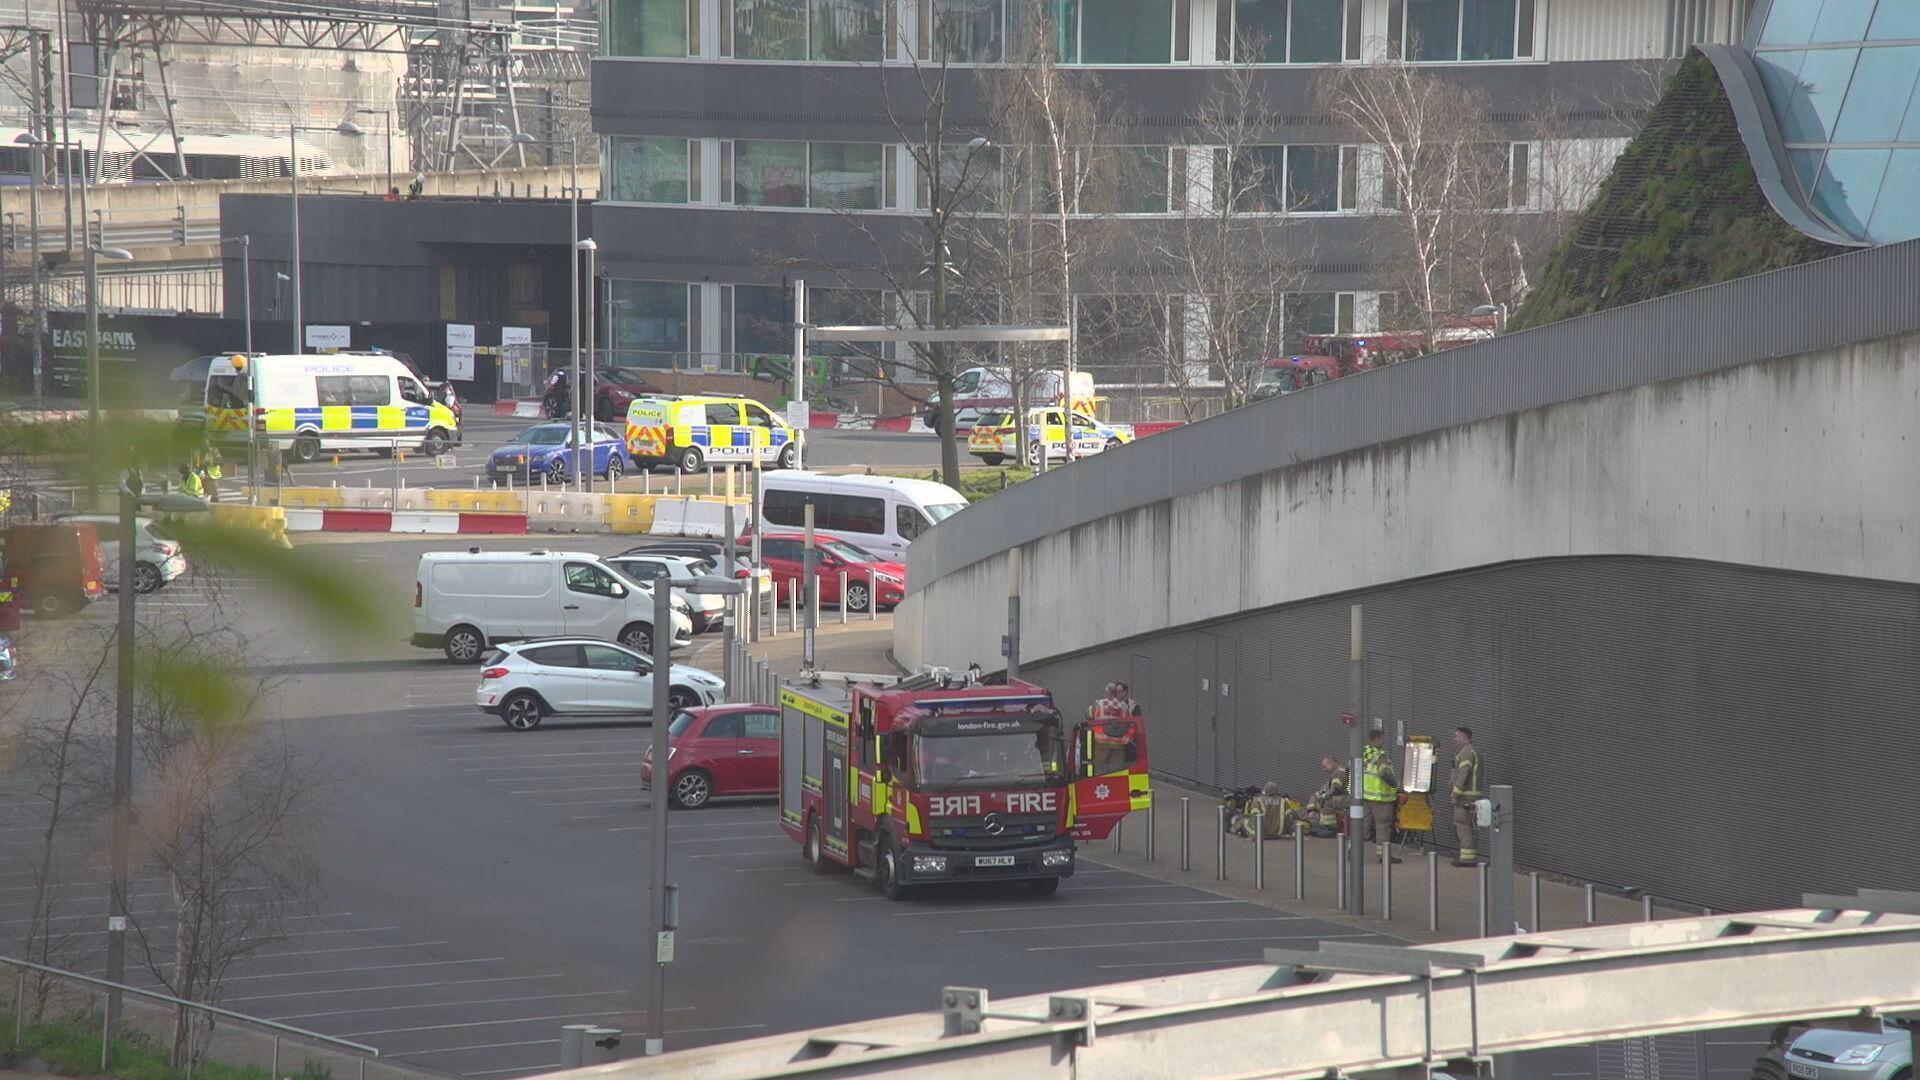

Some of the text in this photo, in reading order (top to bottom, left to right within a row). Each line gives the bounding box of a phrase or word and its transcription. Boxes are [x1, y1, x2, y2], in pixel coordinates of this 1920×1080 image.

[304, 364, 356, 374] POLICE
[632, 408, 663, 418] POLICE
[957, 720, 1021, 730] london-fire.gov.uk
[1006, 792, 1057, 813] FIRE
